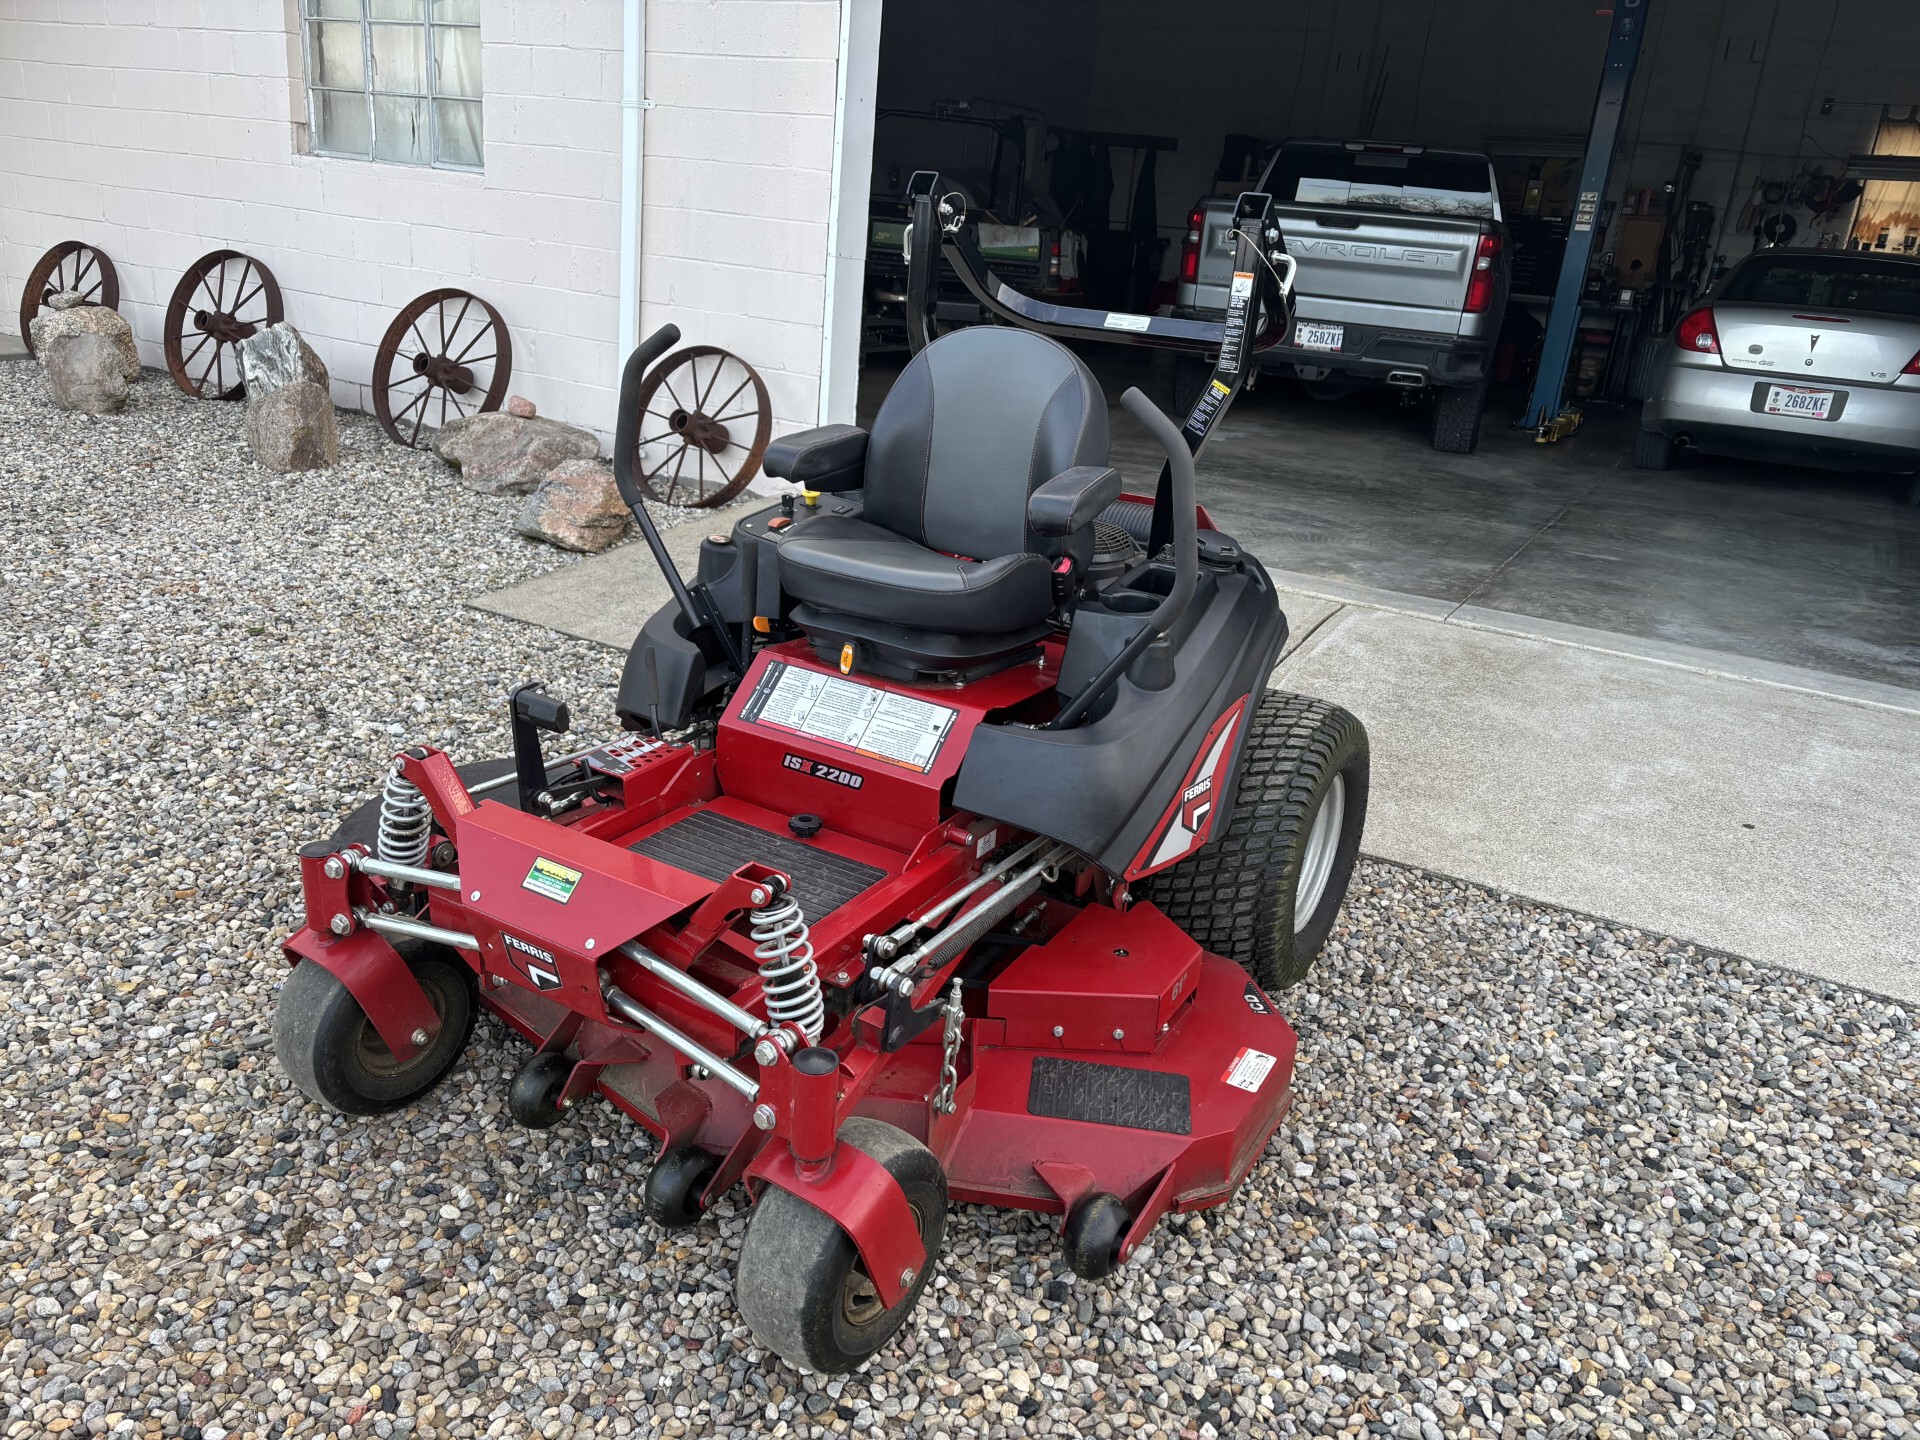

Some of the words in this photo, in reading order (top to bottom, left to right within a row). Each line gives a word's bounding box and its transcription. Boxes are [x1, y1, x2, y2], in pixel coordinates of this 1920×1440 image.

[1307, 330, 1343, 346] 258ZKF
[1784, 394, 1828, 411] 268ZKF
[783, 754, 814, 774] ISX
[815, 764, 863, 789] 2200
[1184, 777, 1211, 802] FERRIS
[504, 935, 553, 964] FERRIS
[1244, 994, 1268, 1014] iCD
